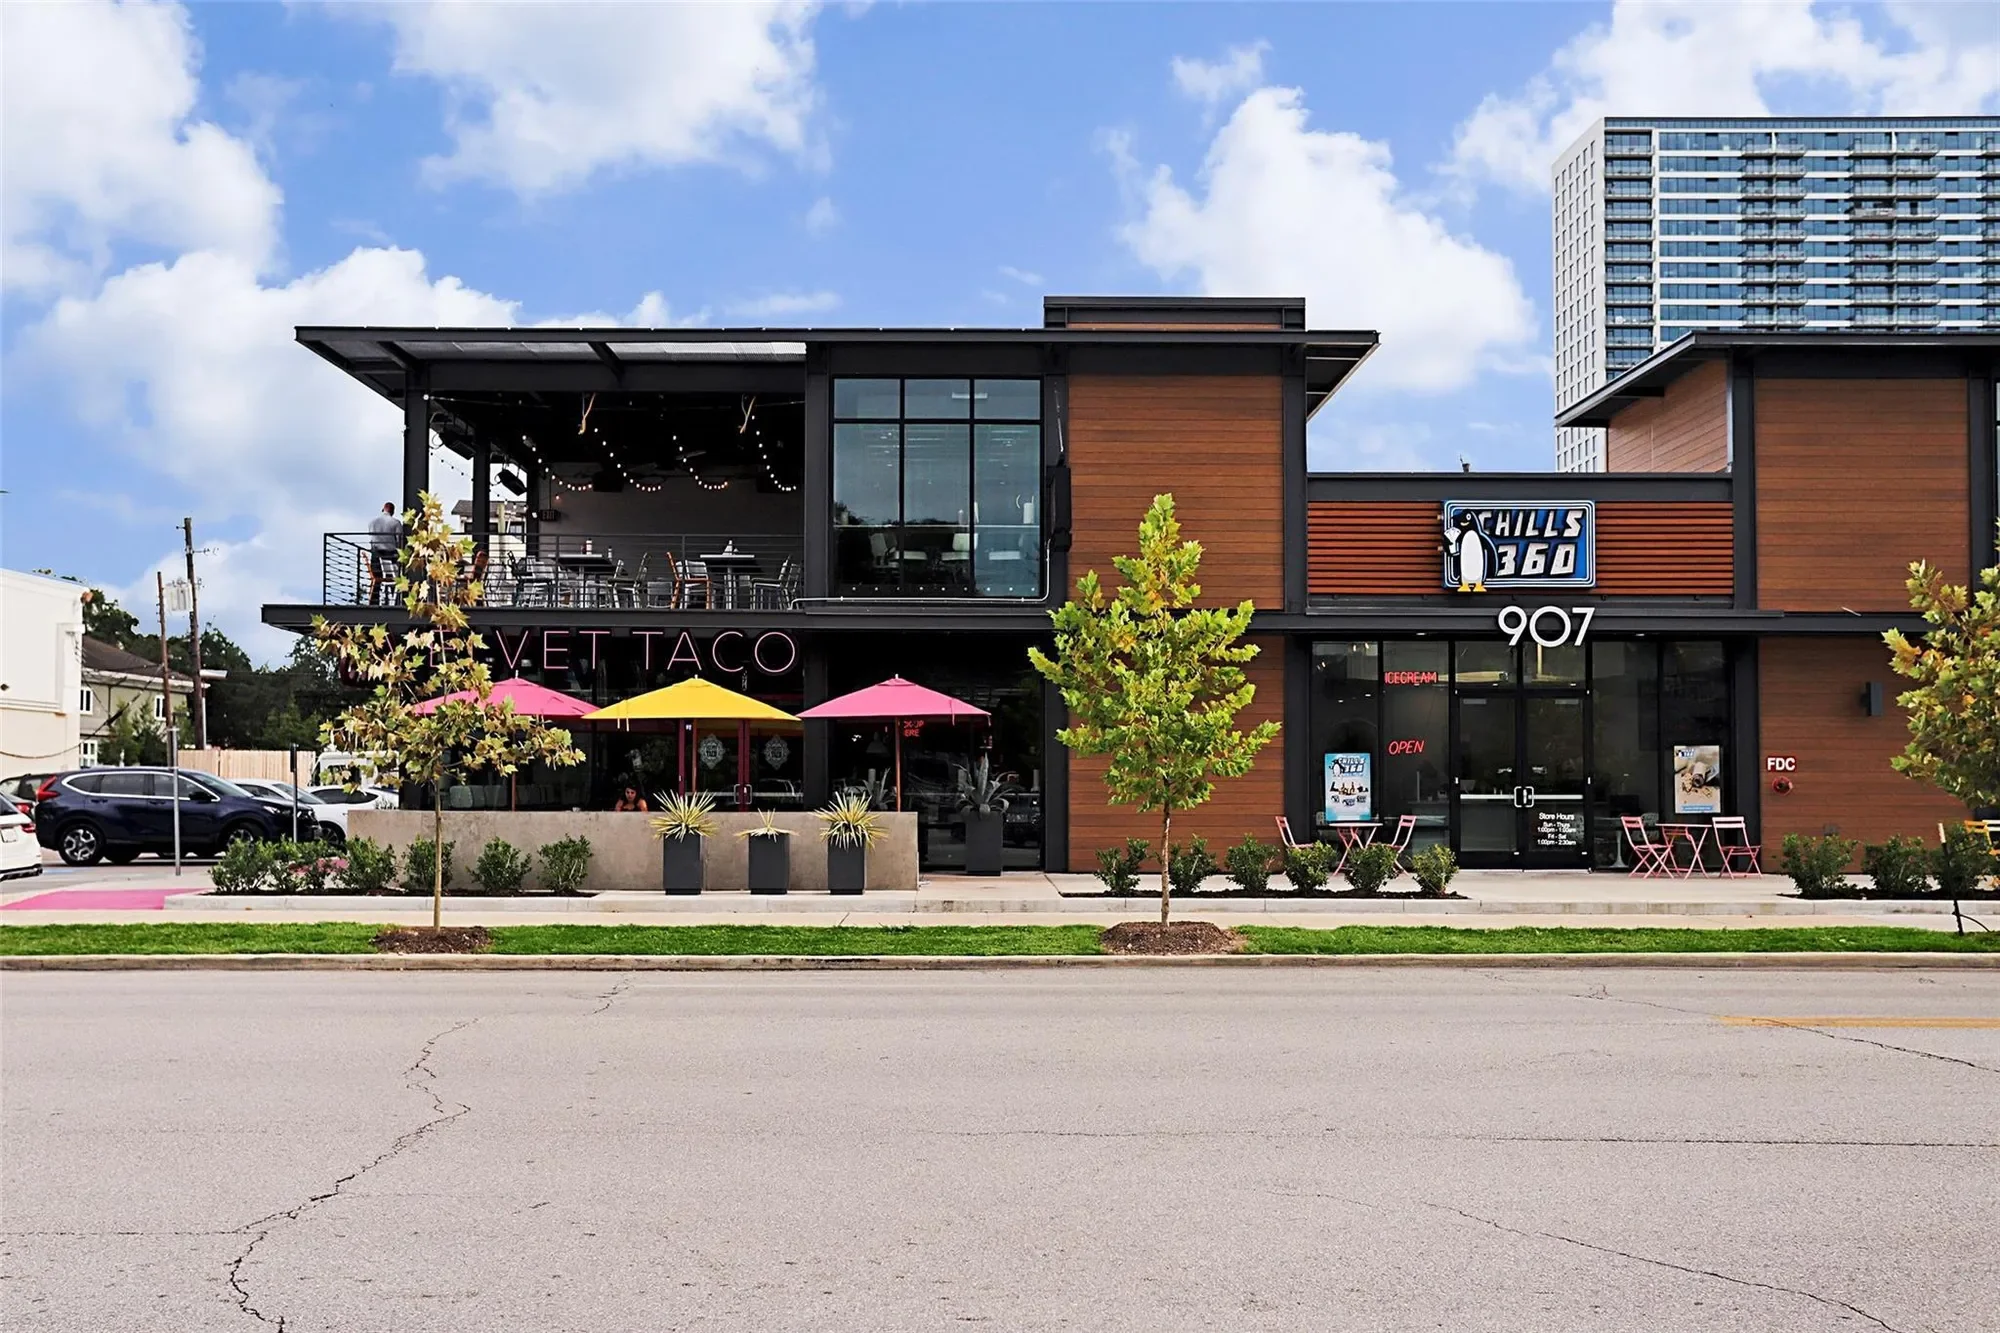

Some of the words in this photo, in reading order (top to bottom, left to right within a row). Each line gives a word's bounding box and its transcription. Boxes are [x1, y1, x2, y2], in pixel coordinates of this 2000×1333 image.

[1479, 510, 1583, 537] CHILLS
[1497, 543, 1576, 576] 360
[1498, 605, 1595, 648] 907
[632, 630, 796, 673] TACO
[1384, 671, 1437, 684] ICECREAM
[1388, 740, 1424, 755] OPEN
[1767, 757, 1796, 771] FDC
[1539, 812, 1555, 820] Store
[1556, 812, 1574, 820] Hours
